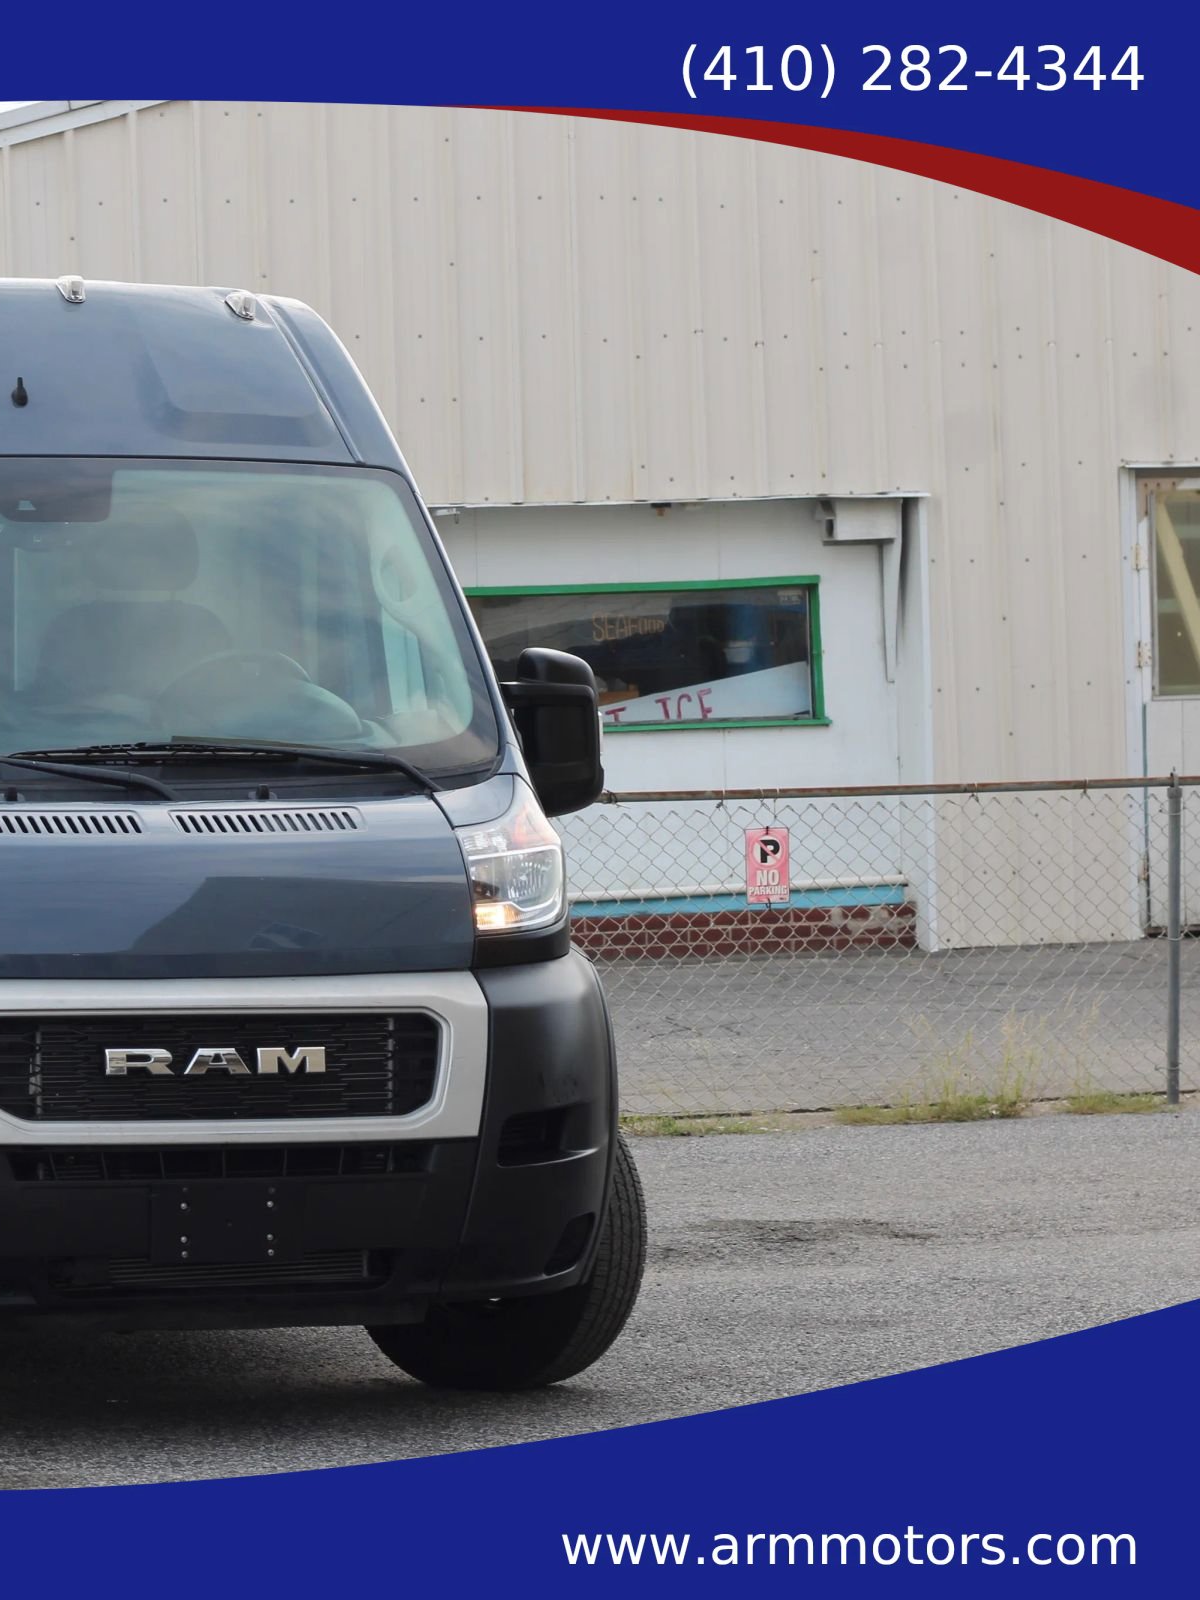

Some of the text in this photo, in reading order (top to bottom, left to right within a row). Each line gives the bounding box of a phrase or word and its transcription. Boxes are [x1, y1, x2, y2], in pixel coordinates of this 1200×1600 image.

[756, 869, 780, 886] NO
[749, 886, 788, 896] PARKING
[105, 1046, 326, 1075] RAM
